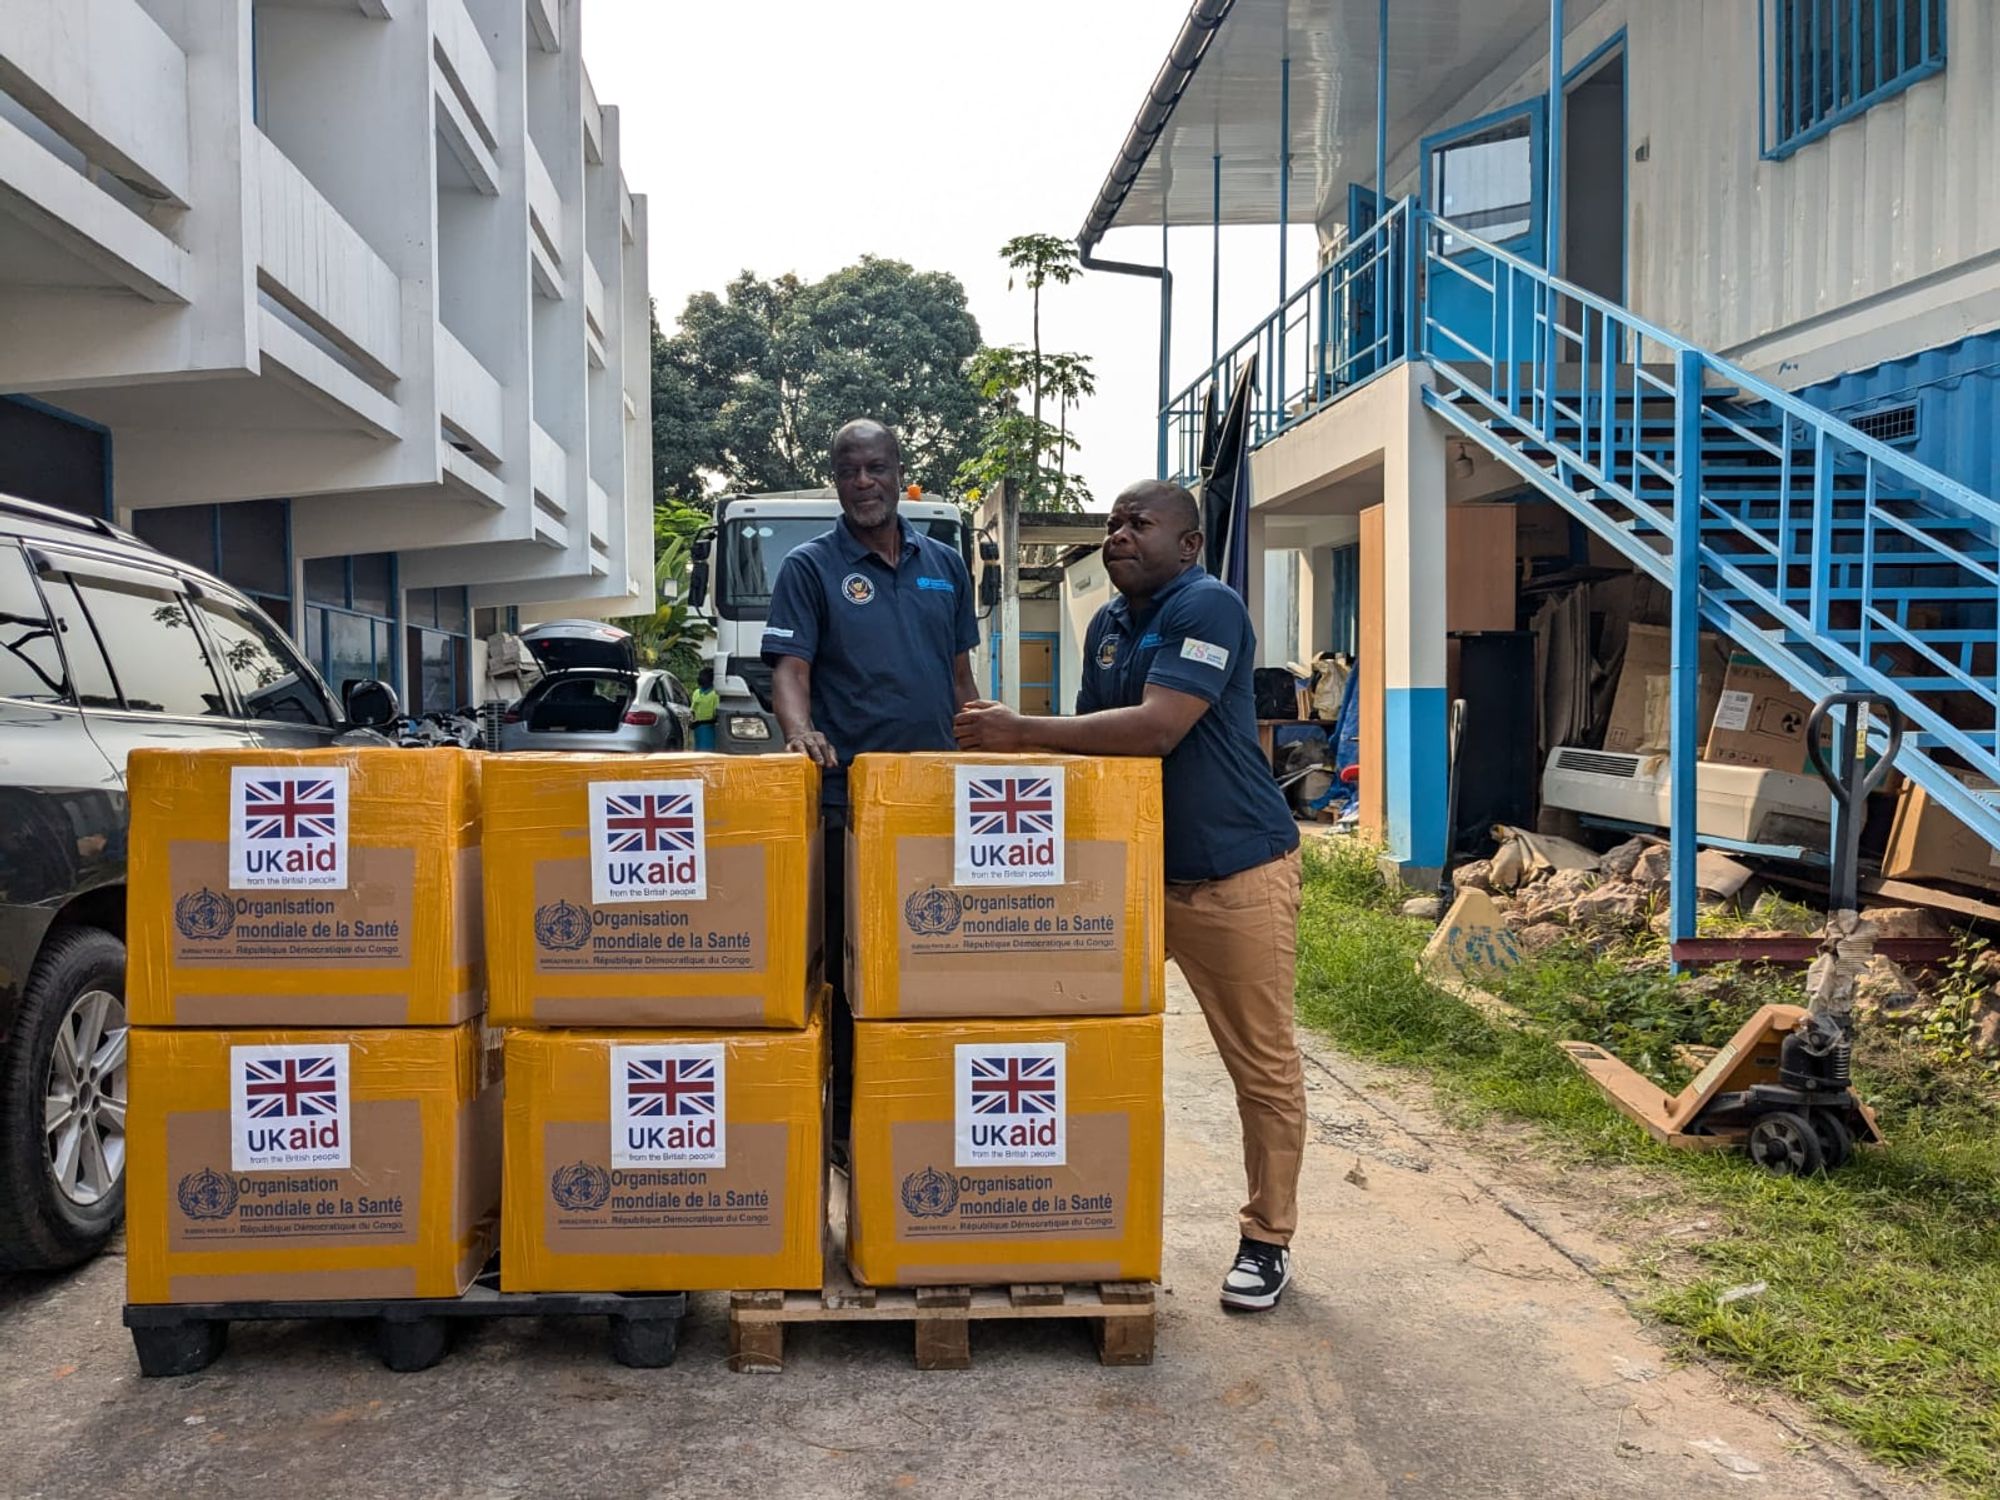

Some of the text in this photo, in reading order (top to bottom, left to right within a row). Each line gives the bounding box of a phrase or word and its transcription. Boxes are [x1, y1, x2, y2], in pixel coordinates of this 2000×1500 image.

[309, 877, 336, 885] people
[1029, 870, 1054, 878] people
[610, 889, 627, 897] from
[644, 888, 667, 896] British
[670, 888, 695, 896] people
[236, 898, 334, 918] Organisation
[963, 895, 1054, 913] Organisation
[593, 910, 688, 929] Organisation
[963, 915, 1113, 932] mondiale de la Santé
[236, 920, 398, 938] mondiale de la Santé
[593, 932, 750, 948] mondiale de la Santé
[1087, 938, 1113, 946] Congo
[369, 945, 398, 954] Congo
[722, 956, 750, 964] Congo
[250, 1156, 267, 1164] from
[285, 1154, 310, 1162] British
[313, 1153, 340, 1161] people
[1031, 1150, 1056, 1158] people
[239, 1177, 338, 1197] Organisation
[611, 1170, 706, 1189] Organisation
[959, 1176, 1052, 1195] Organisation
[240, 1196, 402, 1217] mondiale de la Santé
[612, 1190, 768, 1209] mondiale de la Santé
[960, 1193, 1112, 1214] mondiale de la Santé
[373, 1221, 403, 1229] Congo
[726, 1214, 737, 1222] du
[739, 1214, 768, 1222] Congo
[1084, 1217, 1112, 1226] Congo
